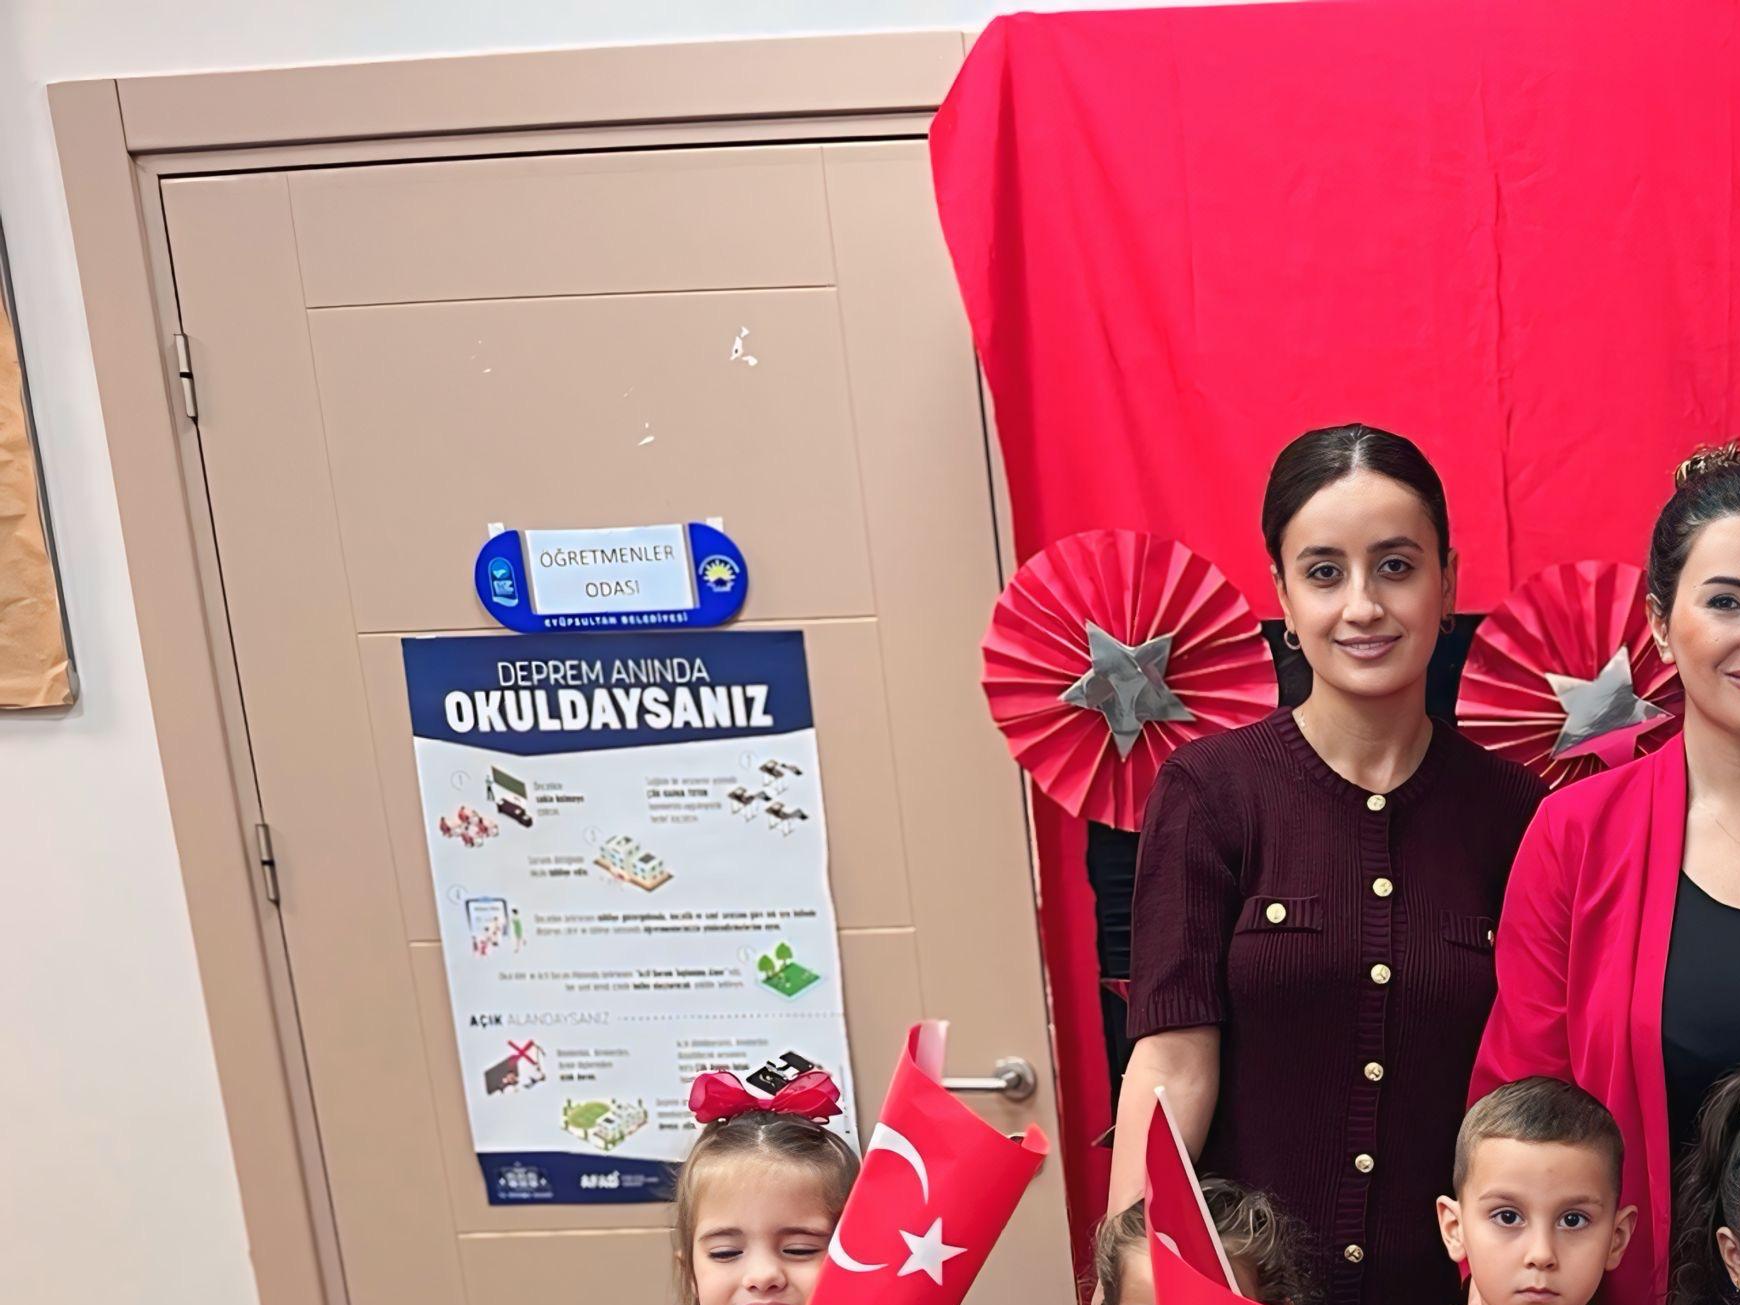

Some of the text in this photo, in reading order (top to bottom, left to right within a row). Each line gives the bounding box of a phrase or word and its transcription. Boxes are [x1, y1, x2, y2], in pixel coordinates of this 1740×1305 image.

[540, 545, 675, 569] ÖĞRETMENLER
[585, 580, 640, 598] ODASI
[497, 657, 710, 686] DEPREM ANINDA
[444, 684, 774, 733] OKULDAYSANIZ
[469, 1014, 503, 1028] AÇIK
